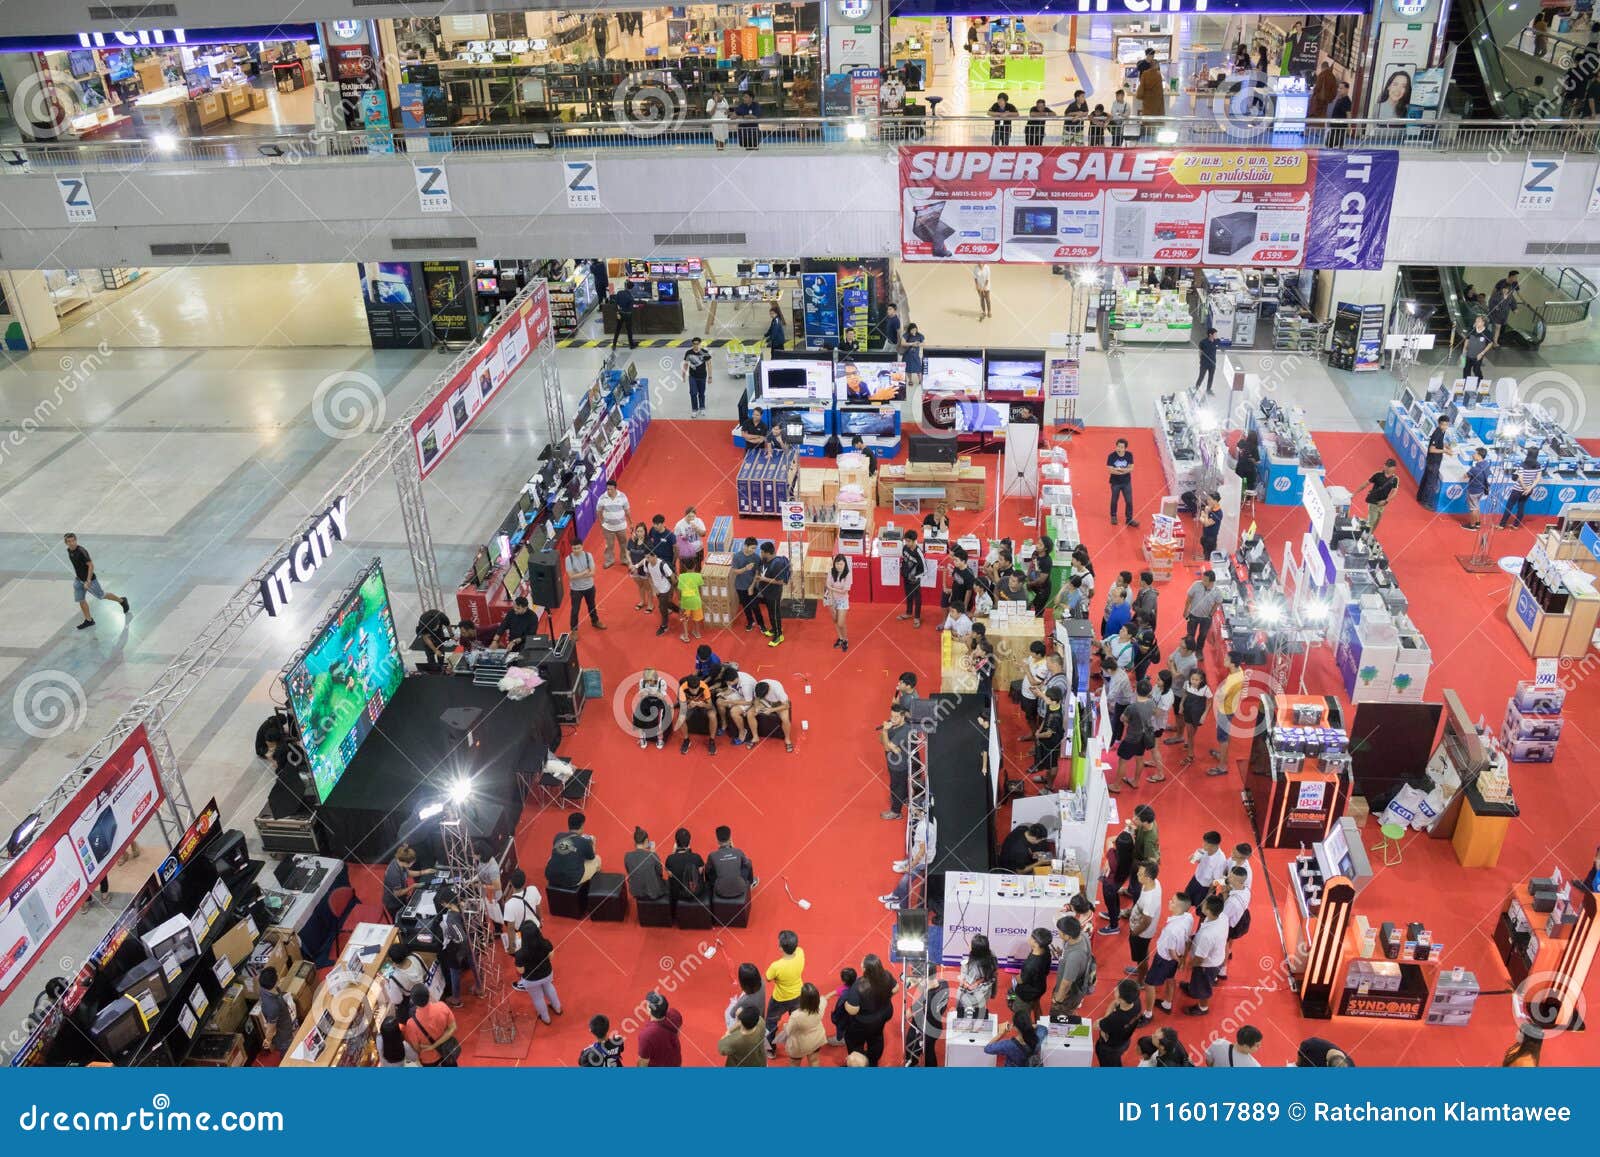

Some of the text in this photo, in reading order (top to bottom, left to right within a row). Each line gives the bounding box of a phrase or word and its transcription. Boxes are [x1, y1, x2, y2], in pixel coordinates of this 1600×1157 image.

[842, 40, 857, 50] F7
[1303, 42, 1318, 53] F5
[1392, 39, 1408, 50] F7
[909, 151, 1159, 183] SUPER SALE
[1236, 156, 1243, 166] 6
[1273, 154, 1300, 167] 2561
[1215, 166, 1273, 182] ลานโปรโมชั่น
[421, 198, 448, 206] ZEER
[1520, 196, 1552, 204] ZEER
[1333, 155, 1372, 265] IT CITY
[1274, 476, 1291, 492] hp
[1559, 487, 1576, 502] hp
[289, 496, 349, 584] CITY
[949, 924, 983, 934] EPSON
[994, 926, 1028, 936] EPSON
[1349, 999, 1420, 1013] SYNDOME
